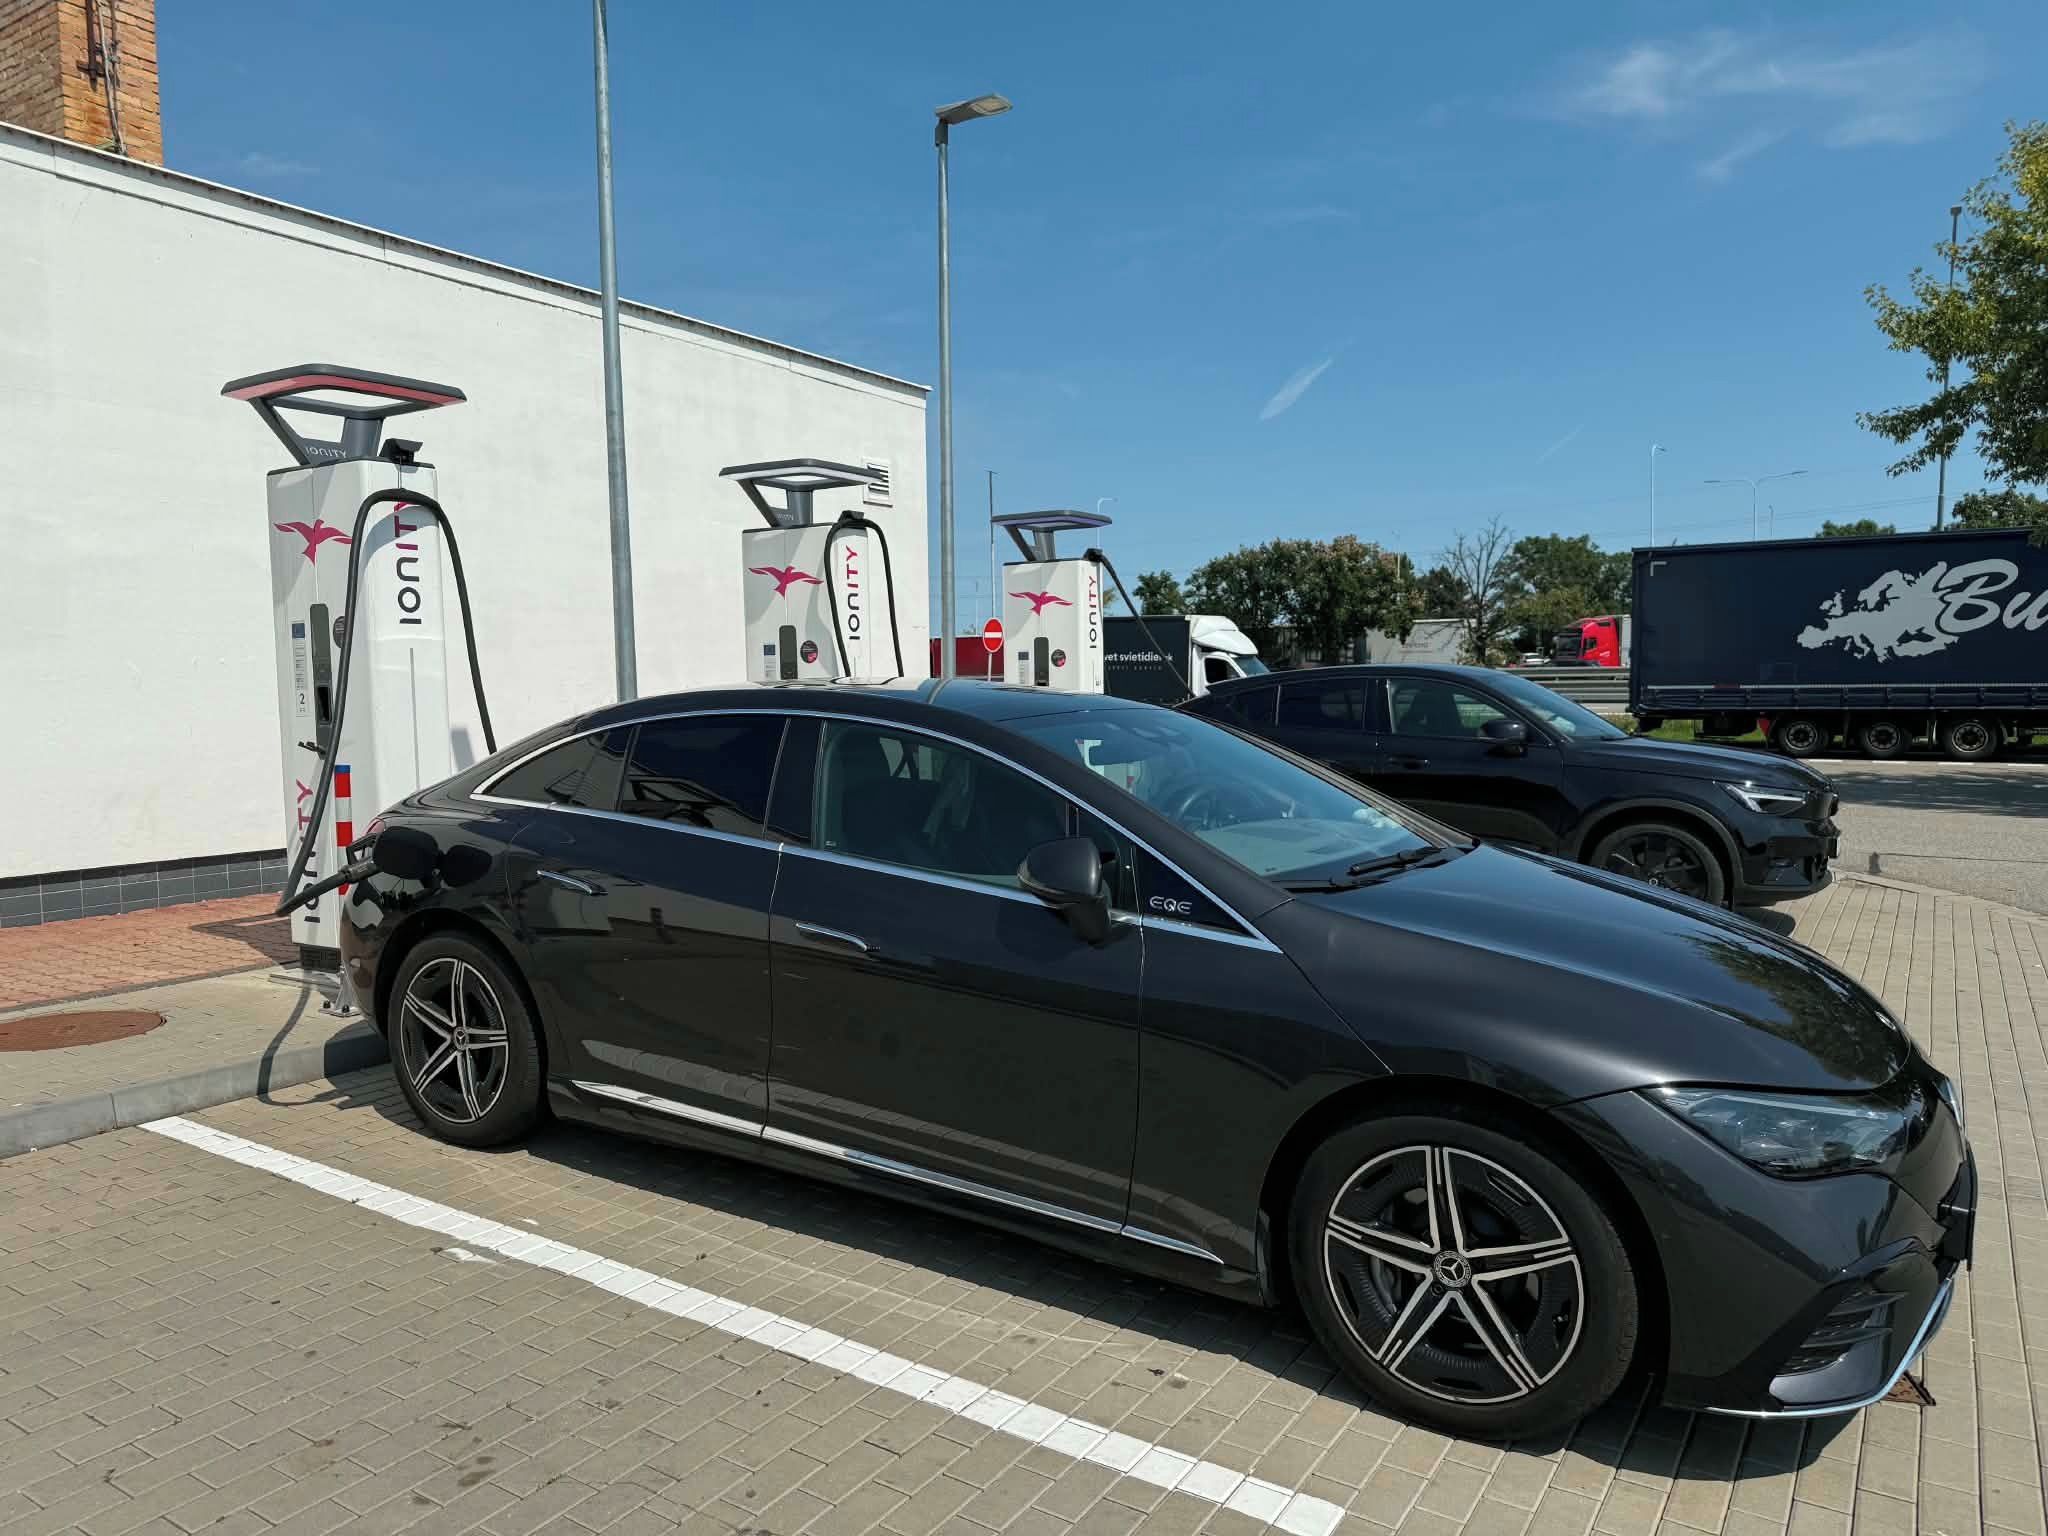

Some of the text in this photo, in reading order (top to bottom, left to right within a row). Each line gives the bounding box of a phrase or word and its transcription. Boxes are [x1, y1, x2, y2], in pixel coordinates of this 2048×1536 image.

[304, 446, 346, 459] IONITY
[846, 545, 861, 640] IONITY
[1088, 575, 1097, 649] IONITY
[1150, 896, 1192, 914] EQE
